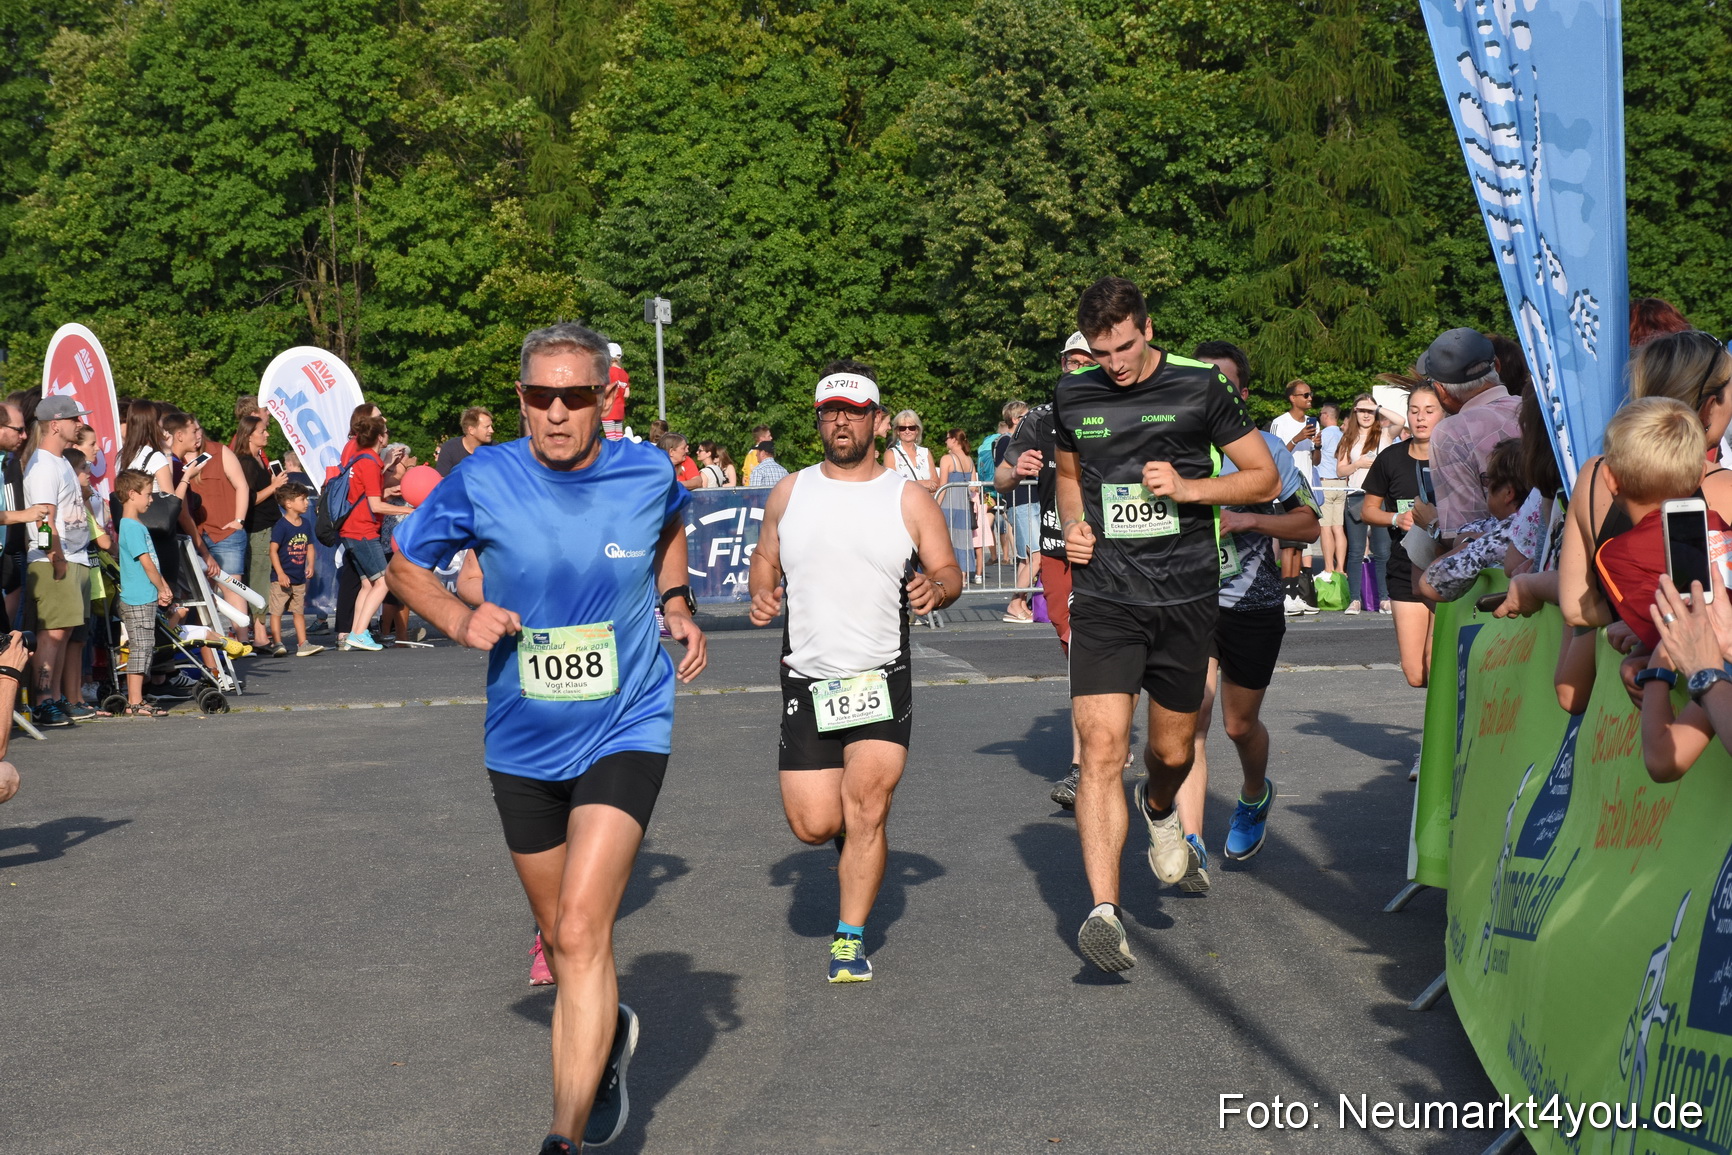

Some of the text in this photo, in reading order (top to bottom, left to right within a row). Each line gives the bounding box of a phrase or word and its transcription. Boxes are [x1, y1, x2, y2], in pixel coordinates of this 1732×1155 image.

[1083, 417, 1104, 425] JAKO
[1111, 501, 1167, 522] 2099
[591, 642, 609, 651] 2019
[528, 651, 604, 680] 1088
[545, 681, 563, 690] Vogt
